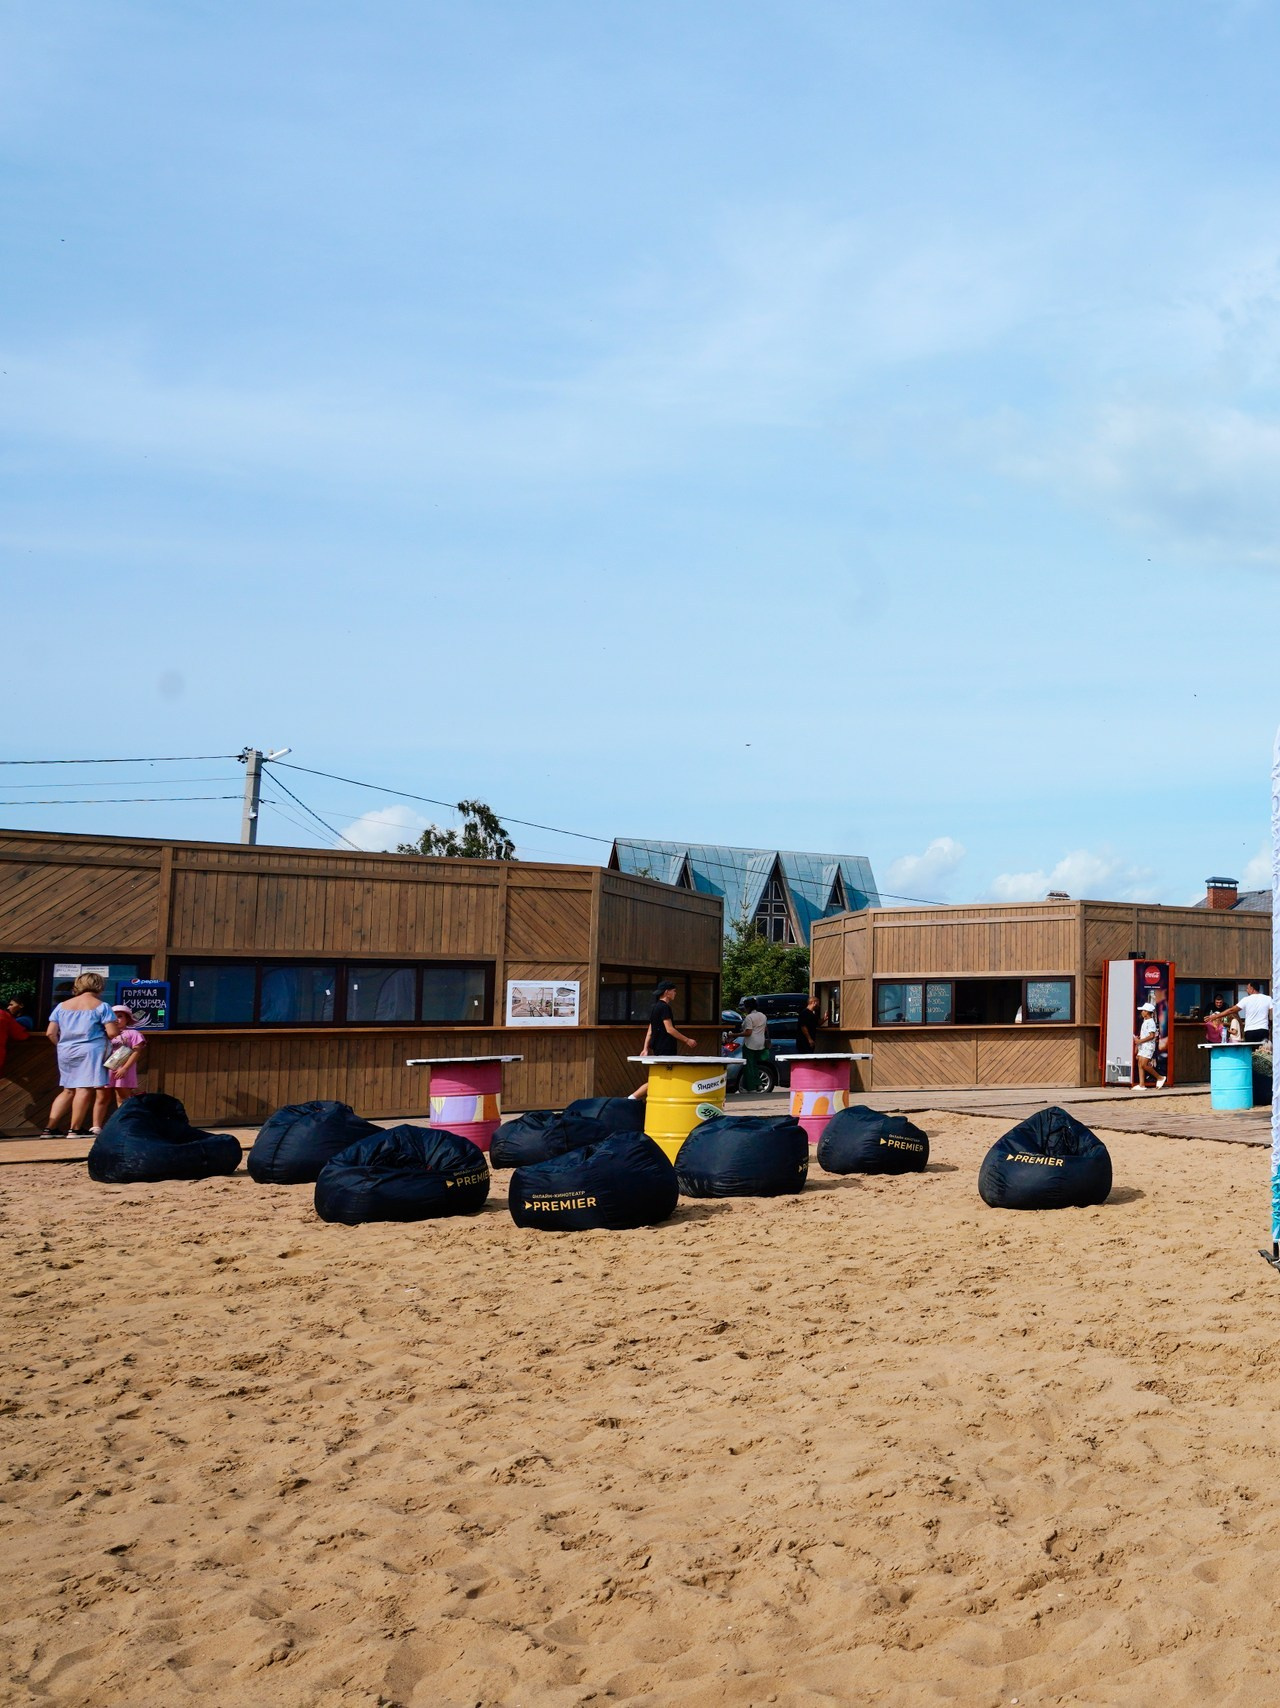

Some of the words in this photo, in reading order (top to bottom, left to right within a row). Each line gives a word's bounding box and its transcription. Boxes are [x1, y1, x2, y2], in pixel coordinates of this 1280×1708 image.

[122, 988, 158, 998] ГОРЯЧАЯ
[122, 999, 167, 1009] КУКУРУЗА
[697, 1081, 720, 1091] Яндекс
[887, 1139, 924, 1152] PREMIER
[1014, 1154, 1064, 1167] PREMIER
[456, 1170, 490, 1187] PREMIE
[533, 1197, 597, 1212] PREMIER
